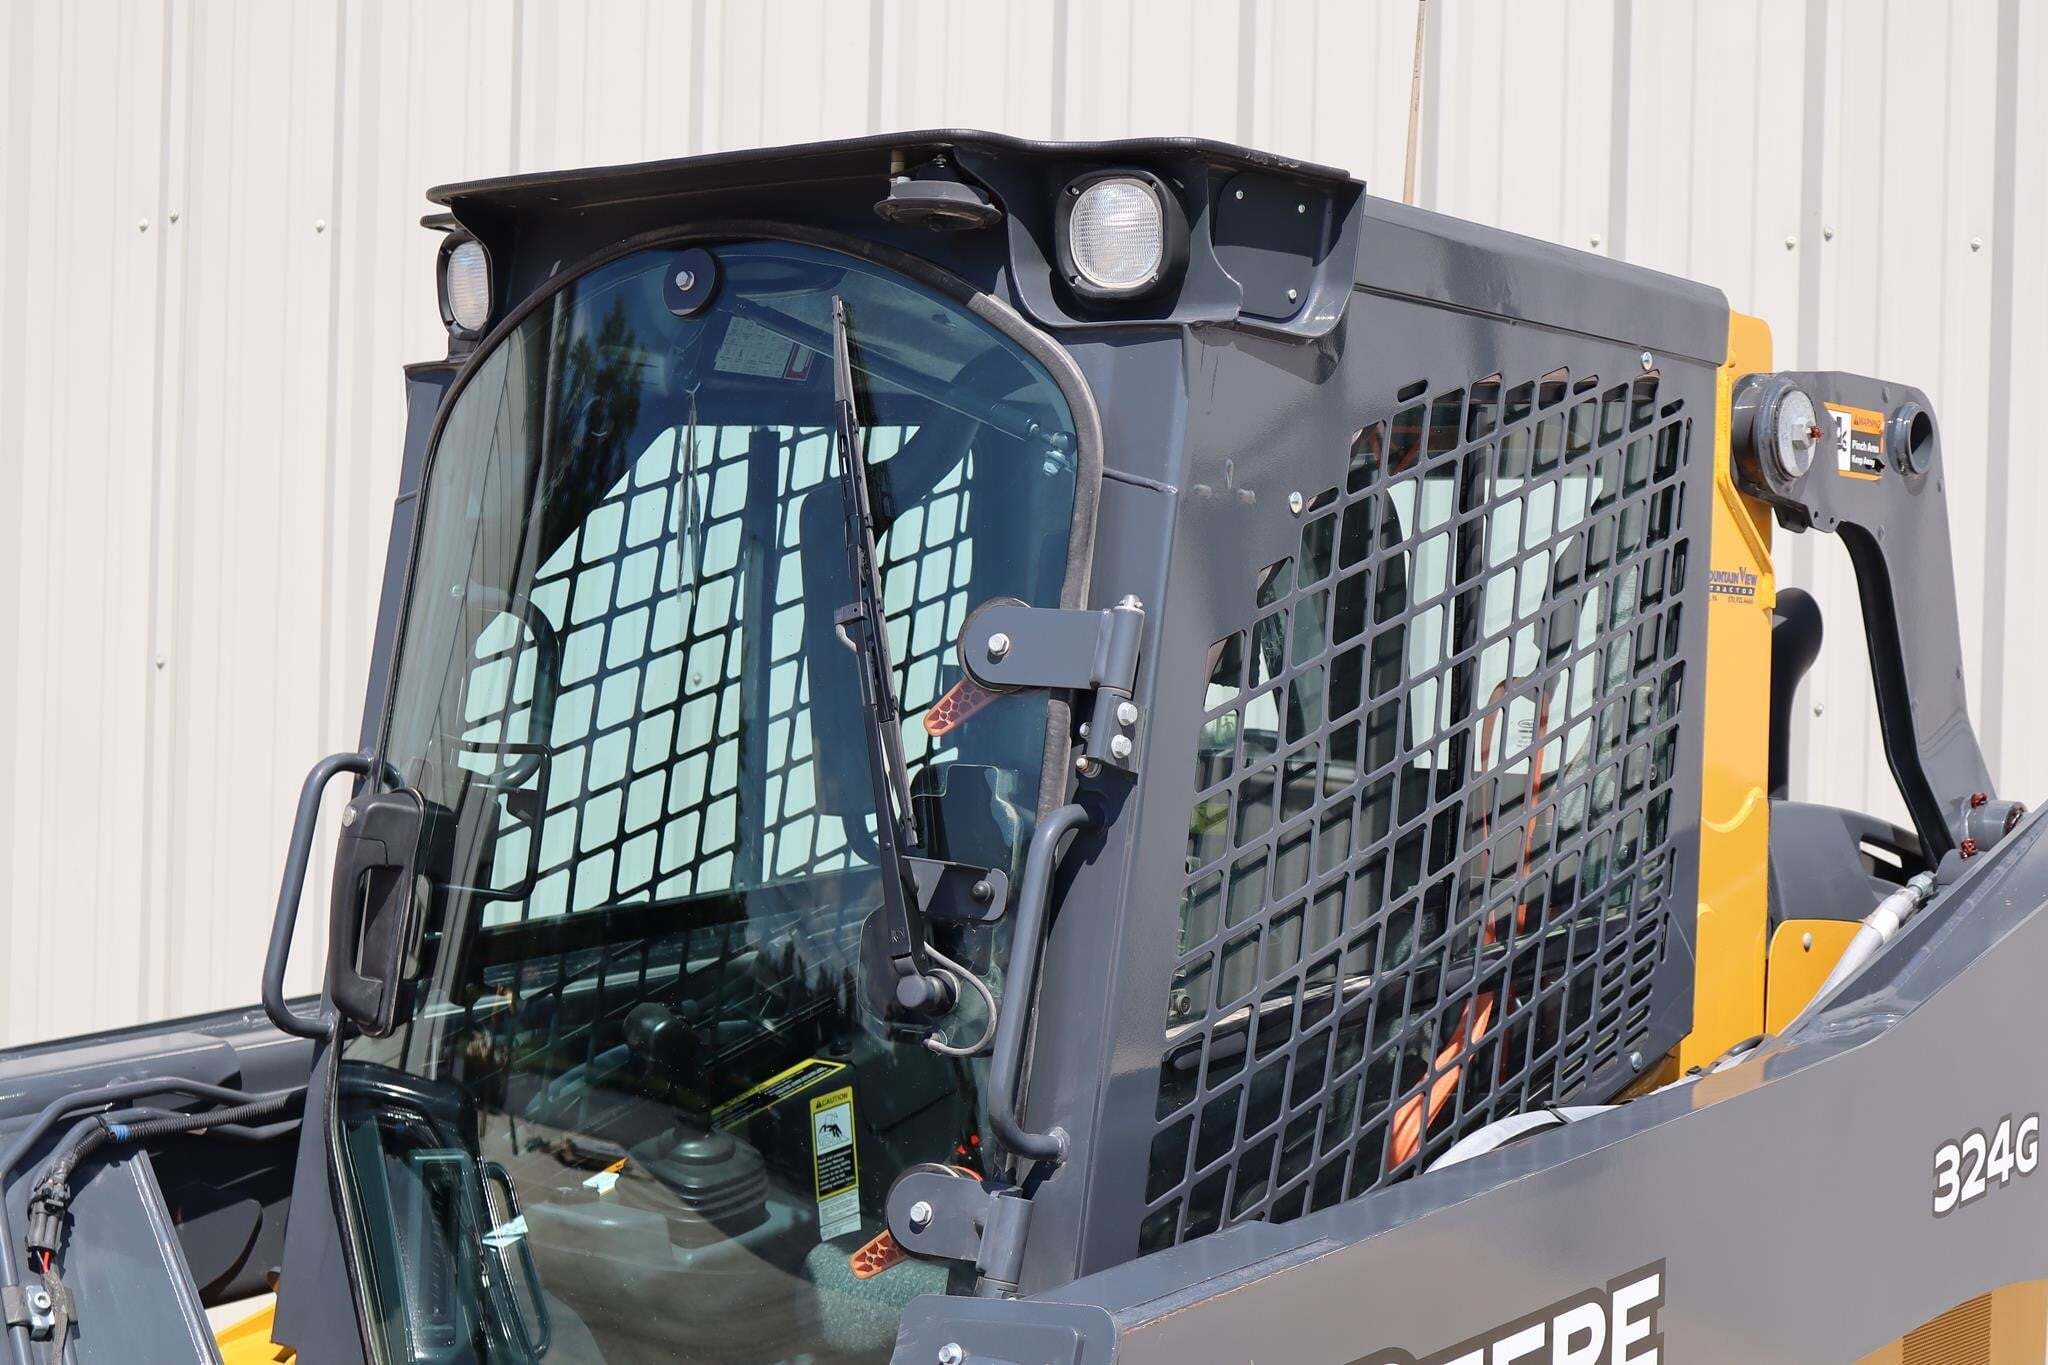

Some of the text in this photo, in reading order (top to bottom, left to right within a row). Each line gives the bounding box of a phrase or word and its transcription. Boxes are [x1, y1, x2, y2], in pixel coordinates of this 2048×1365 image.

[1852, 439, 1880, 454] Pinch Area
[1851, 454, 1876, 468] Keep Away
[822, 1092, 848, 1106] CAUTION
[1934, 1115, 2039, 1213] 324G
